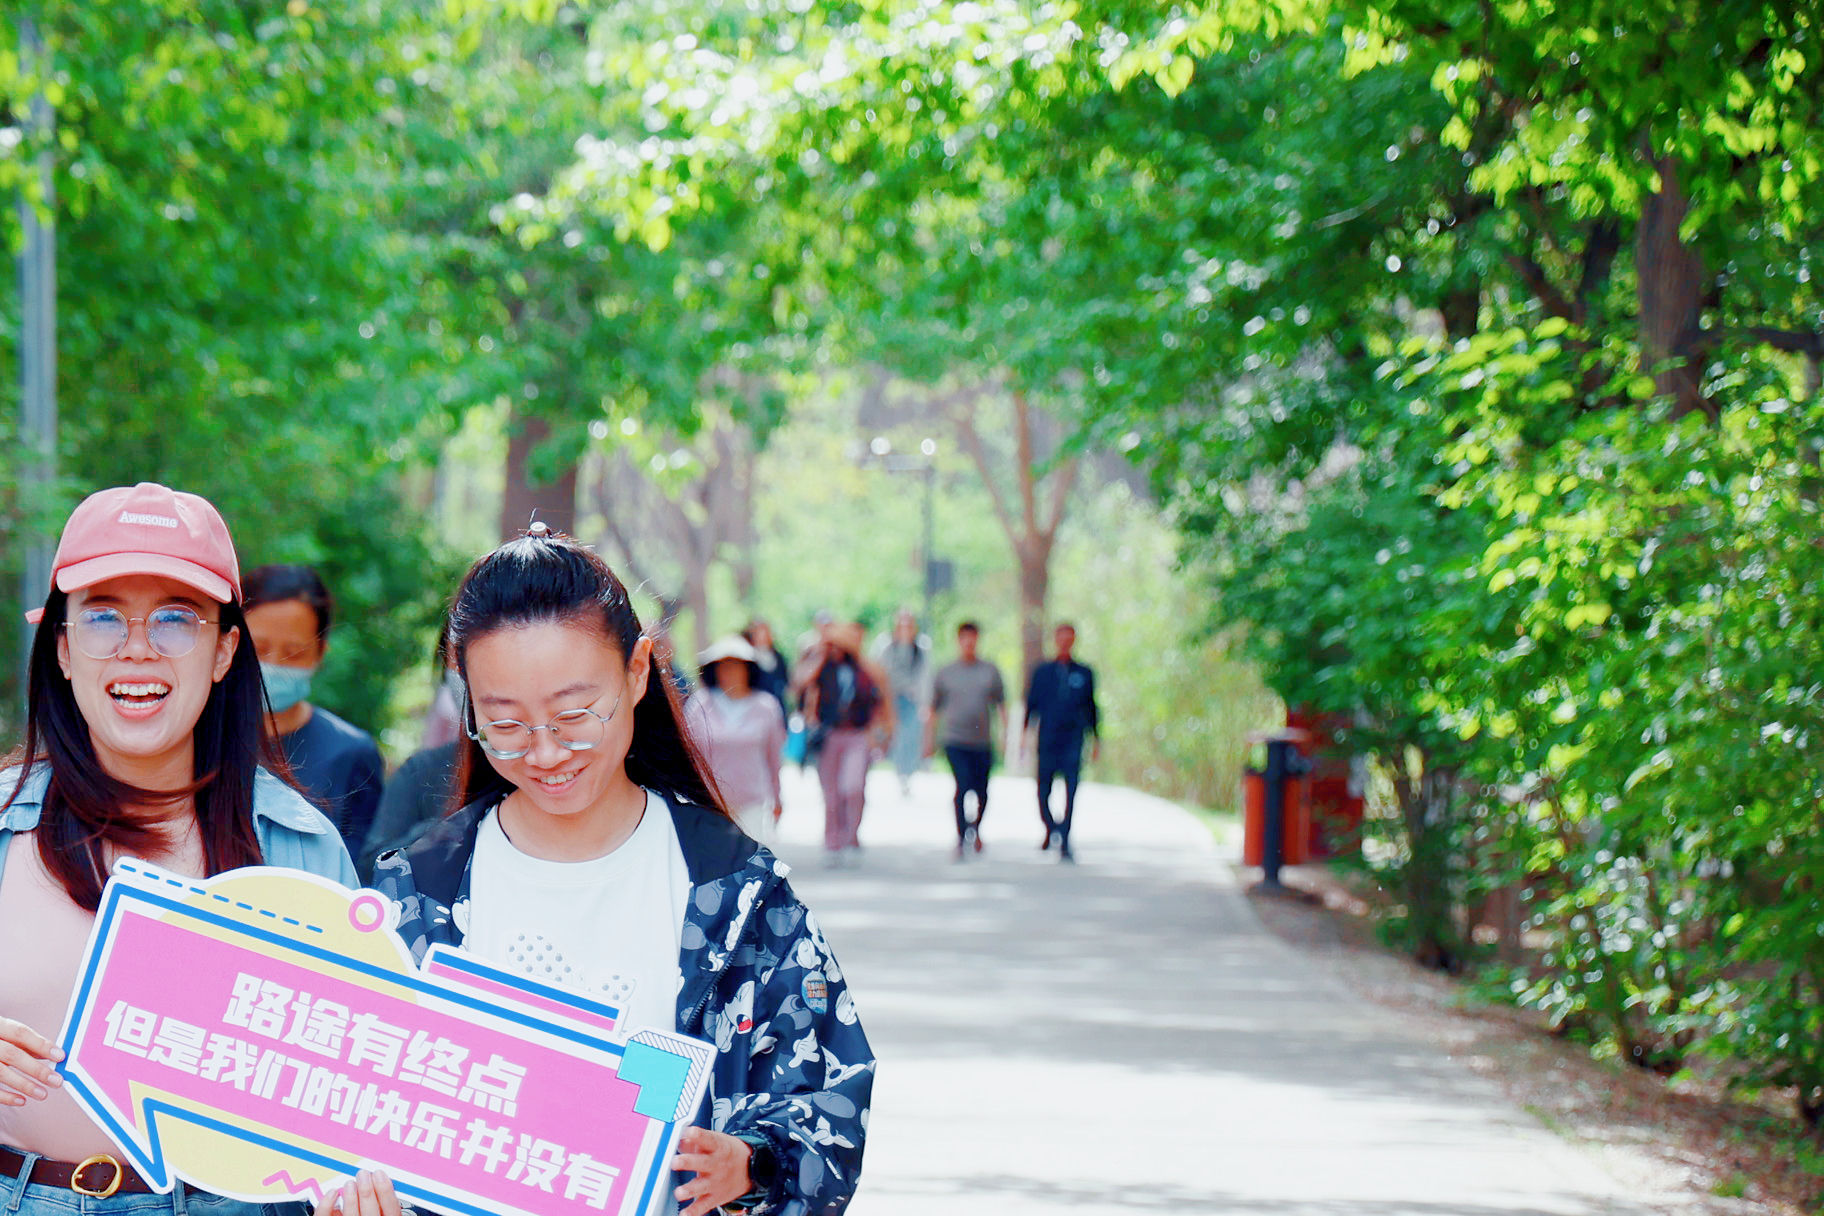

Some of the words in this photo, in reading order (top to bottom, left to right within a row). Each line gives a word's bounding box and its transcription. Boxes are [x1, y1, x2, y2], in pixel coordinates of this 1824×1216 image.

[118, 511, 178, 528] Awesome
[103, 1000, 620, 1210] 但是我们的快乐并没有
[222, 972, 528, 1117] 路途有终点
